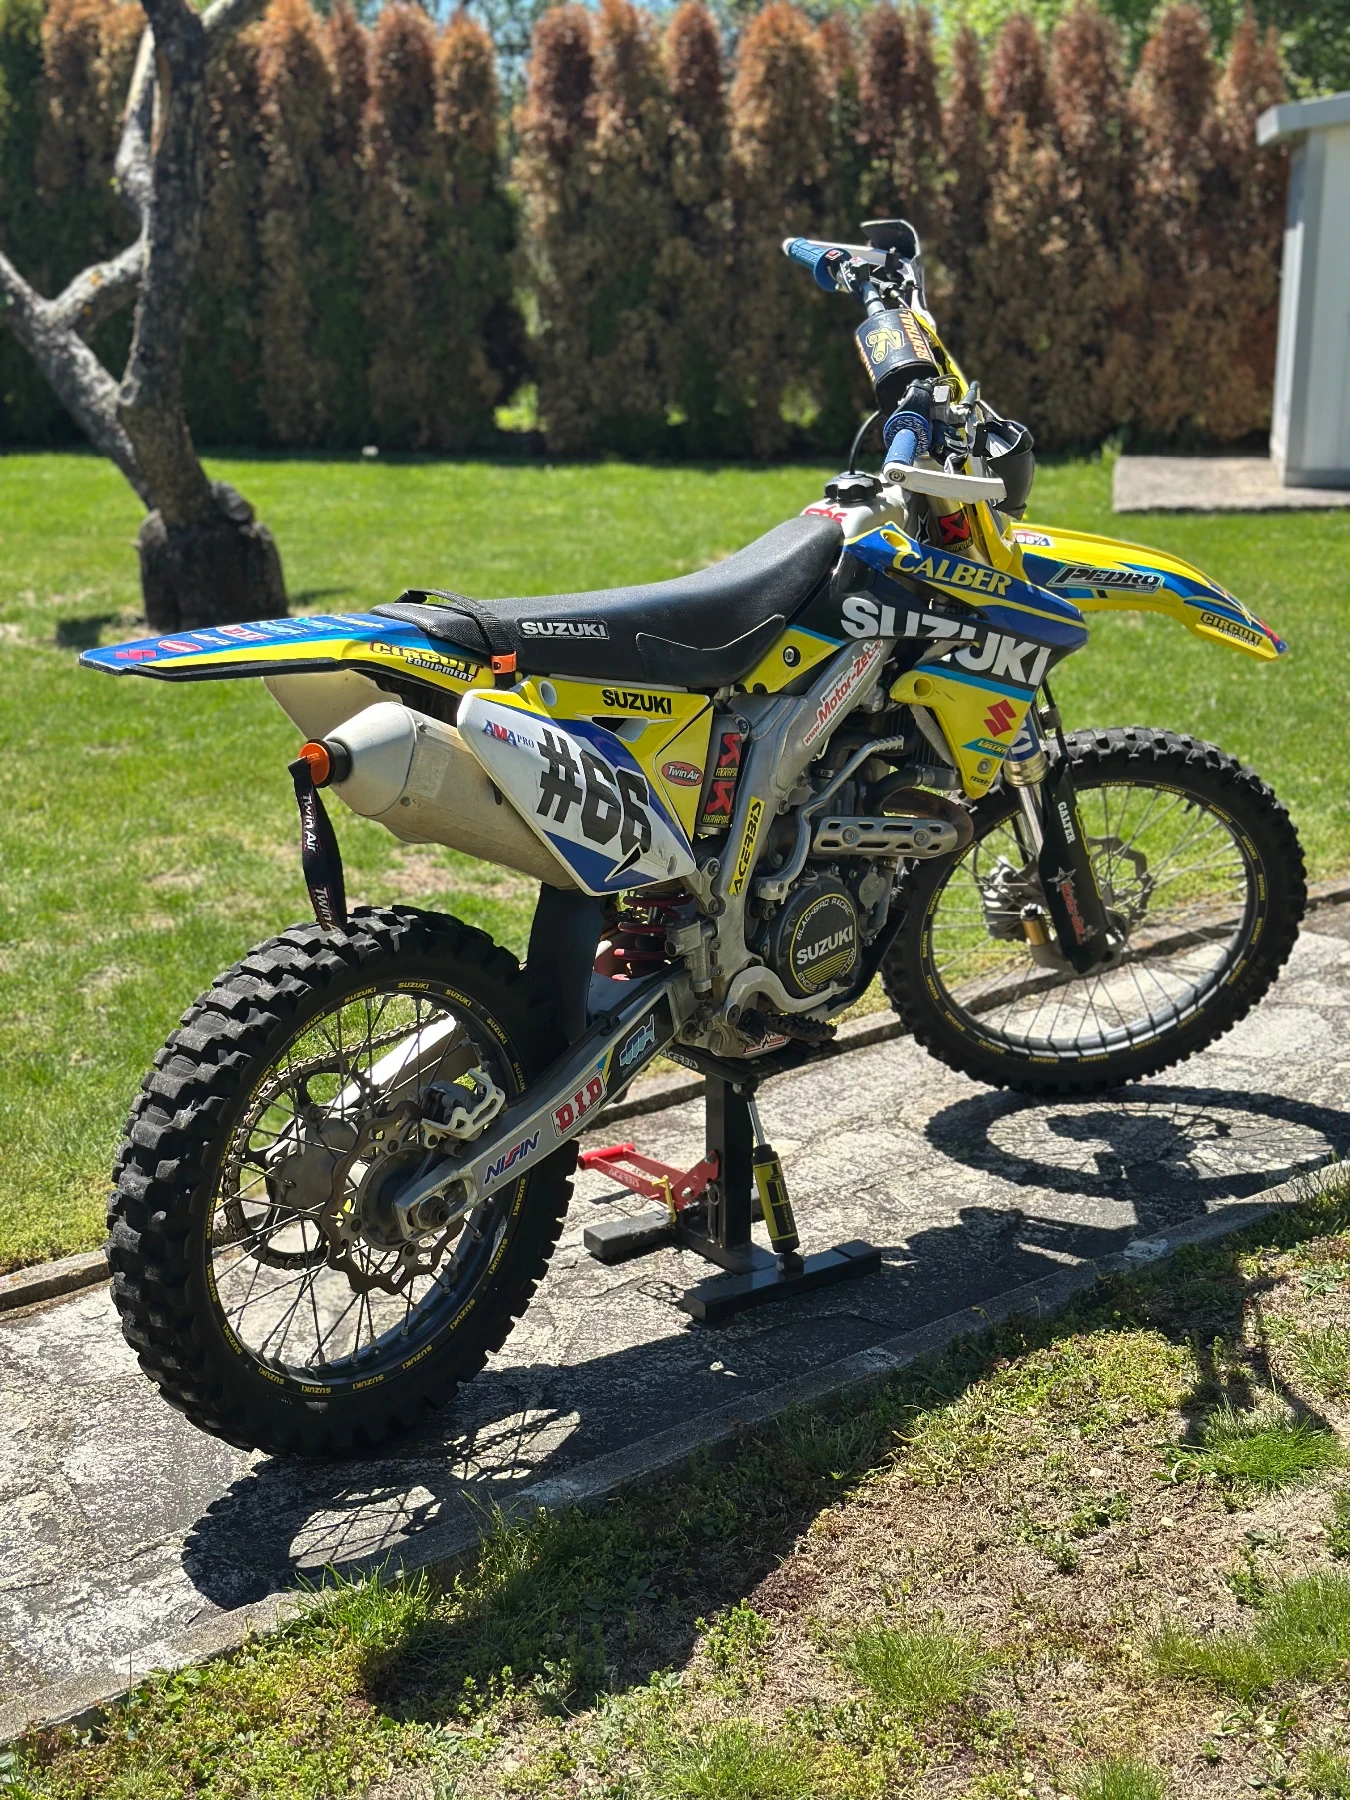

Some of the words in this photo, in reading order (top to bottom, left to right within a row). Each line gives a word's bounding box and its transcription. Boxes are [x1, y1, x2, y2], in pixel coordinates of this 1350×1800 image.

[899, 312, 933, 361] RENTHAL
[893, 552, 1011, 595] CALBER
[1053, 567, 1161, 586] PEDRO
[521, 621, 607, 637] SUZUKI
[841, 597, 1051, 686] SUZUKI
[1202, 613, 1261, 644] CIRCUIT
[371, 642, 482, 676] CIRCUIT
[406, 656, 475, 682] EQUIPMENT
[602, 689, 672, 715] SUZUKI
[483, 719, 518, 748] AMA
[517, 735, 535, 749] PRO
[667, 765, 686, 778] Twin
[685, 768, 700, 781] Air
[536, 727, 652, 855] #66
[302, 793, 315, 829] Twin
[994, 808, 1021, 828] SUZUK
[1057, 801, 1076, 844] GALFER
[304, 830, 317, 854] Air
[733, 801, 762, 894] ACERBIS
[314, 886, 333, 921] Twin
[796, 898, 830, 941] BLACKBIRD
[831, 898, 853, 916] RACING
[796, 925, 854, 966] SUZUKI
[344, 986, 377, 1004] SUZUKI
[397, 981, 430, 990] SUZUKI
[797, 971, 818, 992] ENGINE
[445, 988, 472, 1007] SUZUKI
[486, 1017, 508, 1045] SUZUKI
[661, 1049, 699, 1070] ACERBIS
[513, 1061, 527, 1093] SUZUK
[555, 1076, 603, 1131] D.I.D
[512, 1178, 526, 1216] SUZUKI
[488, 1238, 508, 1275] SUZUKI
[450, 1298, 476, 1331] SUZUKI
[222, 1323, 243, 1355] SUZUKI
[402, 1344, 433, 1370] SUZUKI
[258, 1366, 285, 1386] SUZUKI
[301, 1384, 332, 1394] SUZUKI
[352, 1373, 384, 1390] SUZUKI
